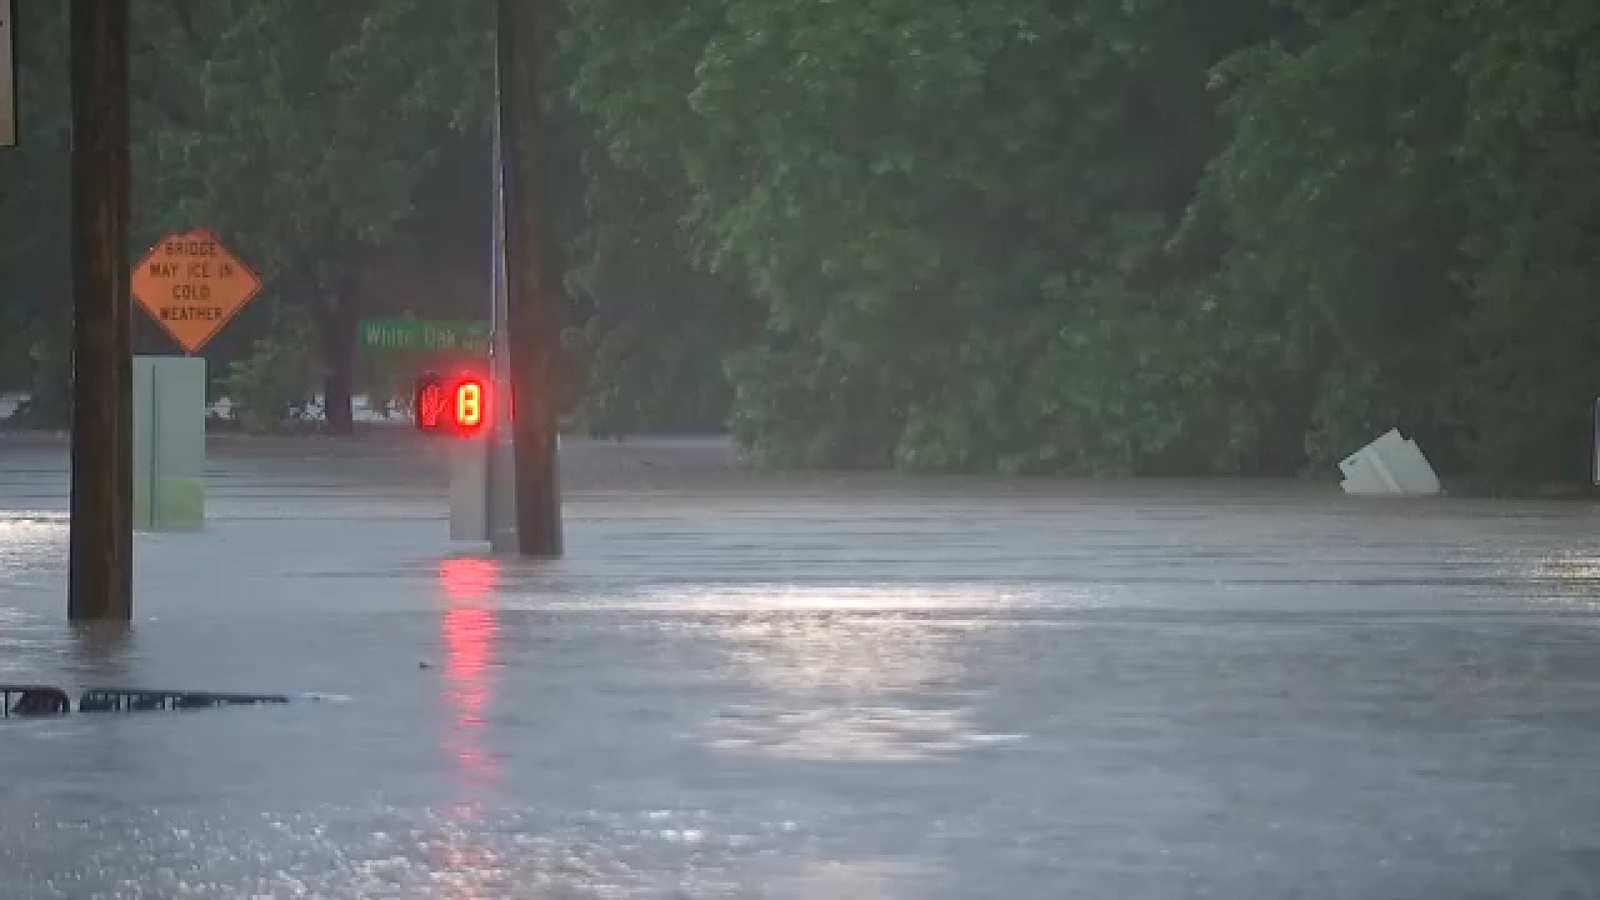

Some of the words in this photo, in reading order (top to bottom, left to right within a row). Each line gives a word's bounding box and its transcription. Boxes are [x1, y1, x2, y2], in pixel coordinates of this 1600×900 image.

[164, 242, 217, 257] BRIDGE
[149, 262, 180, 278] MAY
[187, 262, 210, 278] ICE
[219, 263, 233, 278] IN
[172, 284, 211, 300] COLD
[160, 307, 223, 320] WEATHER
[366, 324, 408, 347] White
[424, 326, 457, 349] Oak
